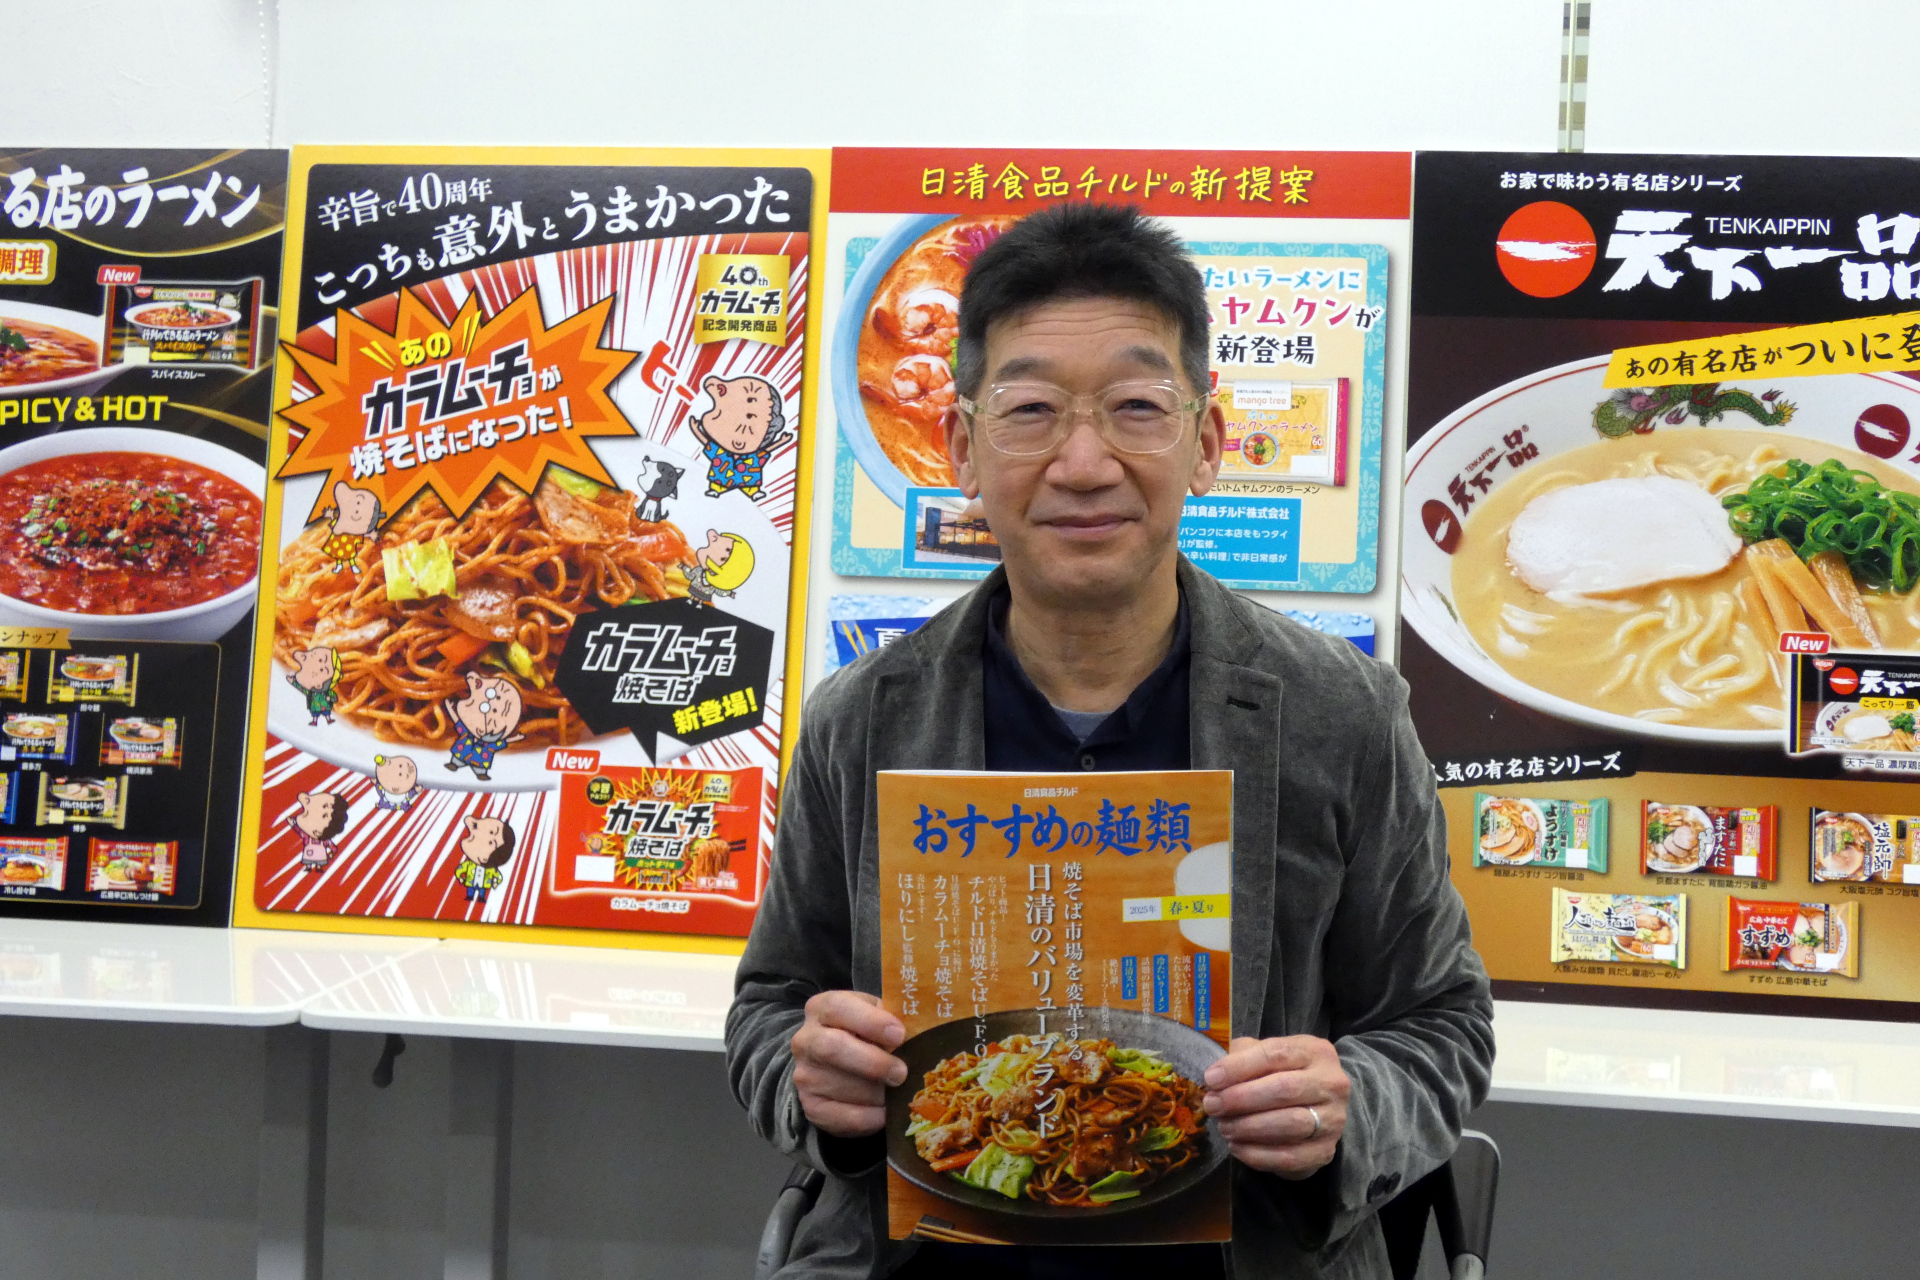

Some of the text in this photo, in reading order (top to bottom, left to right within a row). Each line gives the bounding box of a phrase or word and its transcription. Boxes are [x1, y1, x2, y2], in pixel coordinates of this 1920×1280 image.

[3, 163, 261, 229] る店のラーメン
[920, 163, 1315, 204] 日清食品チルドの新提案
[1500, 171, 1743, 193] お家で味わう有名店シリーズ
[317, 172, 493, 232] 辛旨で40周年
[314, 176, 791, 305] こっちも意外とうまかった
[1705, 216, 1831, 236] TENKAIPPIN
[1602, 209, 1920, 301] 天下一品
[103, 268, 135, 282] New
[699, 289, 782, 315] カラムーチョ
[1208, 296, 1381, 328] ヤムクンが
[703, 319, 778, 332] 記念開発商品
[400, 332, 451, 366] あの
[1216, 333, 1315, 365] 新登場
[151, 370, 206, 380] スパイスカレー
[362, 339, 562, 440] カラムーチョが
[74, 397, 97, 421] &
[103, 396, 169, 421] HOT
[1238, 397, 1286, 406] mango tree
[581, 622, 737, 676] カラムーチョ
[1786, 636, 1824, 651] New
[612, 673, 704, 705] 焼そば
[553, 752, 594, 770] New
[1845, 758, 1885, 769] 天下一品
[1024, 787, 1079, 798] 日清食品チルド
[604, 801, 714, 838] カラムーチョ
[912, 798, 1193, 859] おすすめの麺類
[626, 837, 688, 858] 焼そば
[1713, 816, 1727, 868] ますたに
[611, 897, 688, 912] カラムーチョ焼そば
[1129, 904, 1158, 915] 2025年
[933, 875, 955, 1018] カラムーチョ焼そば
[1062, 861, 1085, 1061] 焼そば市場を変革する
[1024, 863, 1061, 1139] 日清のバリューブランド
